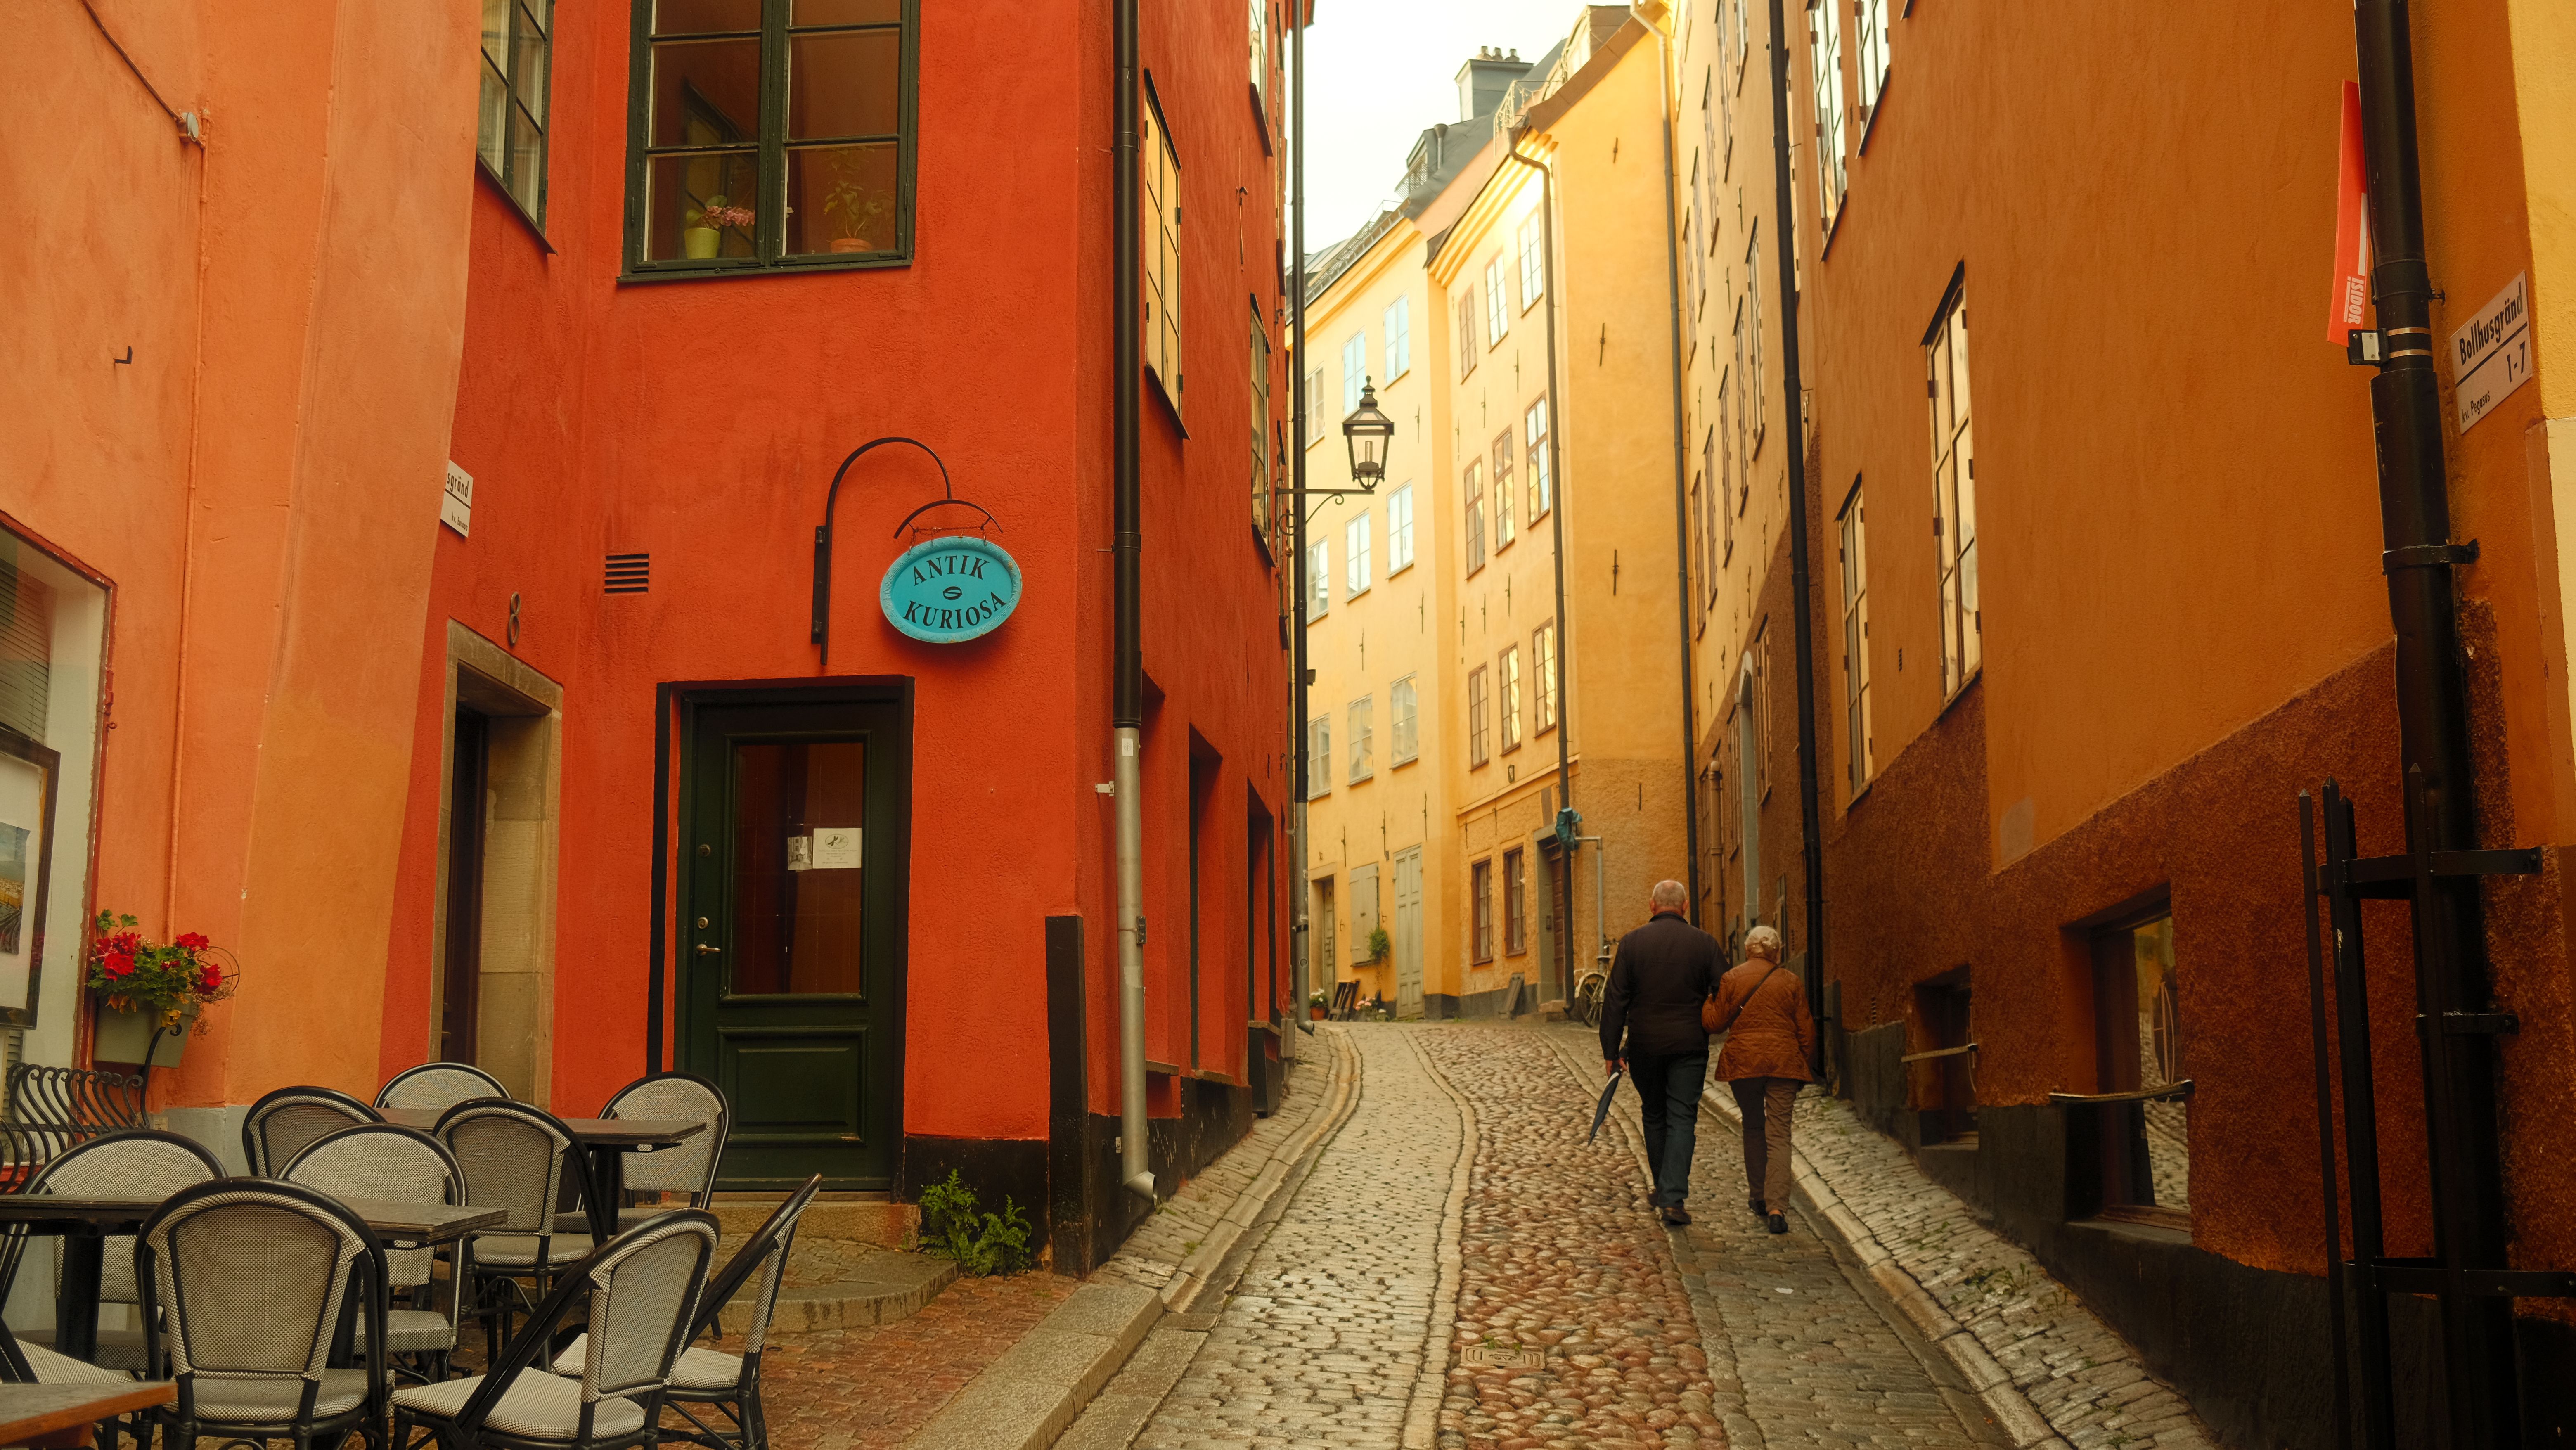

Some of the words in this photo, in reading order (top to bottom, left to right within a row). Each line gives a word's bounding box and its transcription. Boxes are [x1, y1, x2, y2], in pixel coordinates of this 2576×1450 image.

[2459, 281, 2523, 365] Bollhusgränd
[2461, 409, 2469, 424] kv.
[2470, 391, 2490, 416] Pegasus
[457, 516, 468, 532] Europa
[914, 555, 990, 586] ANTIK
[509, 592, 520, 644] 8
[903, 592, 1007, 630] KURIOSA
